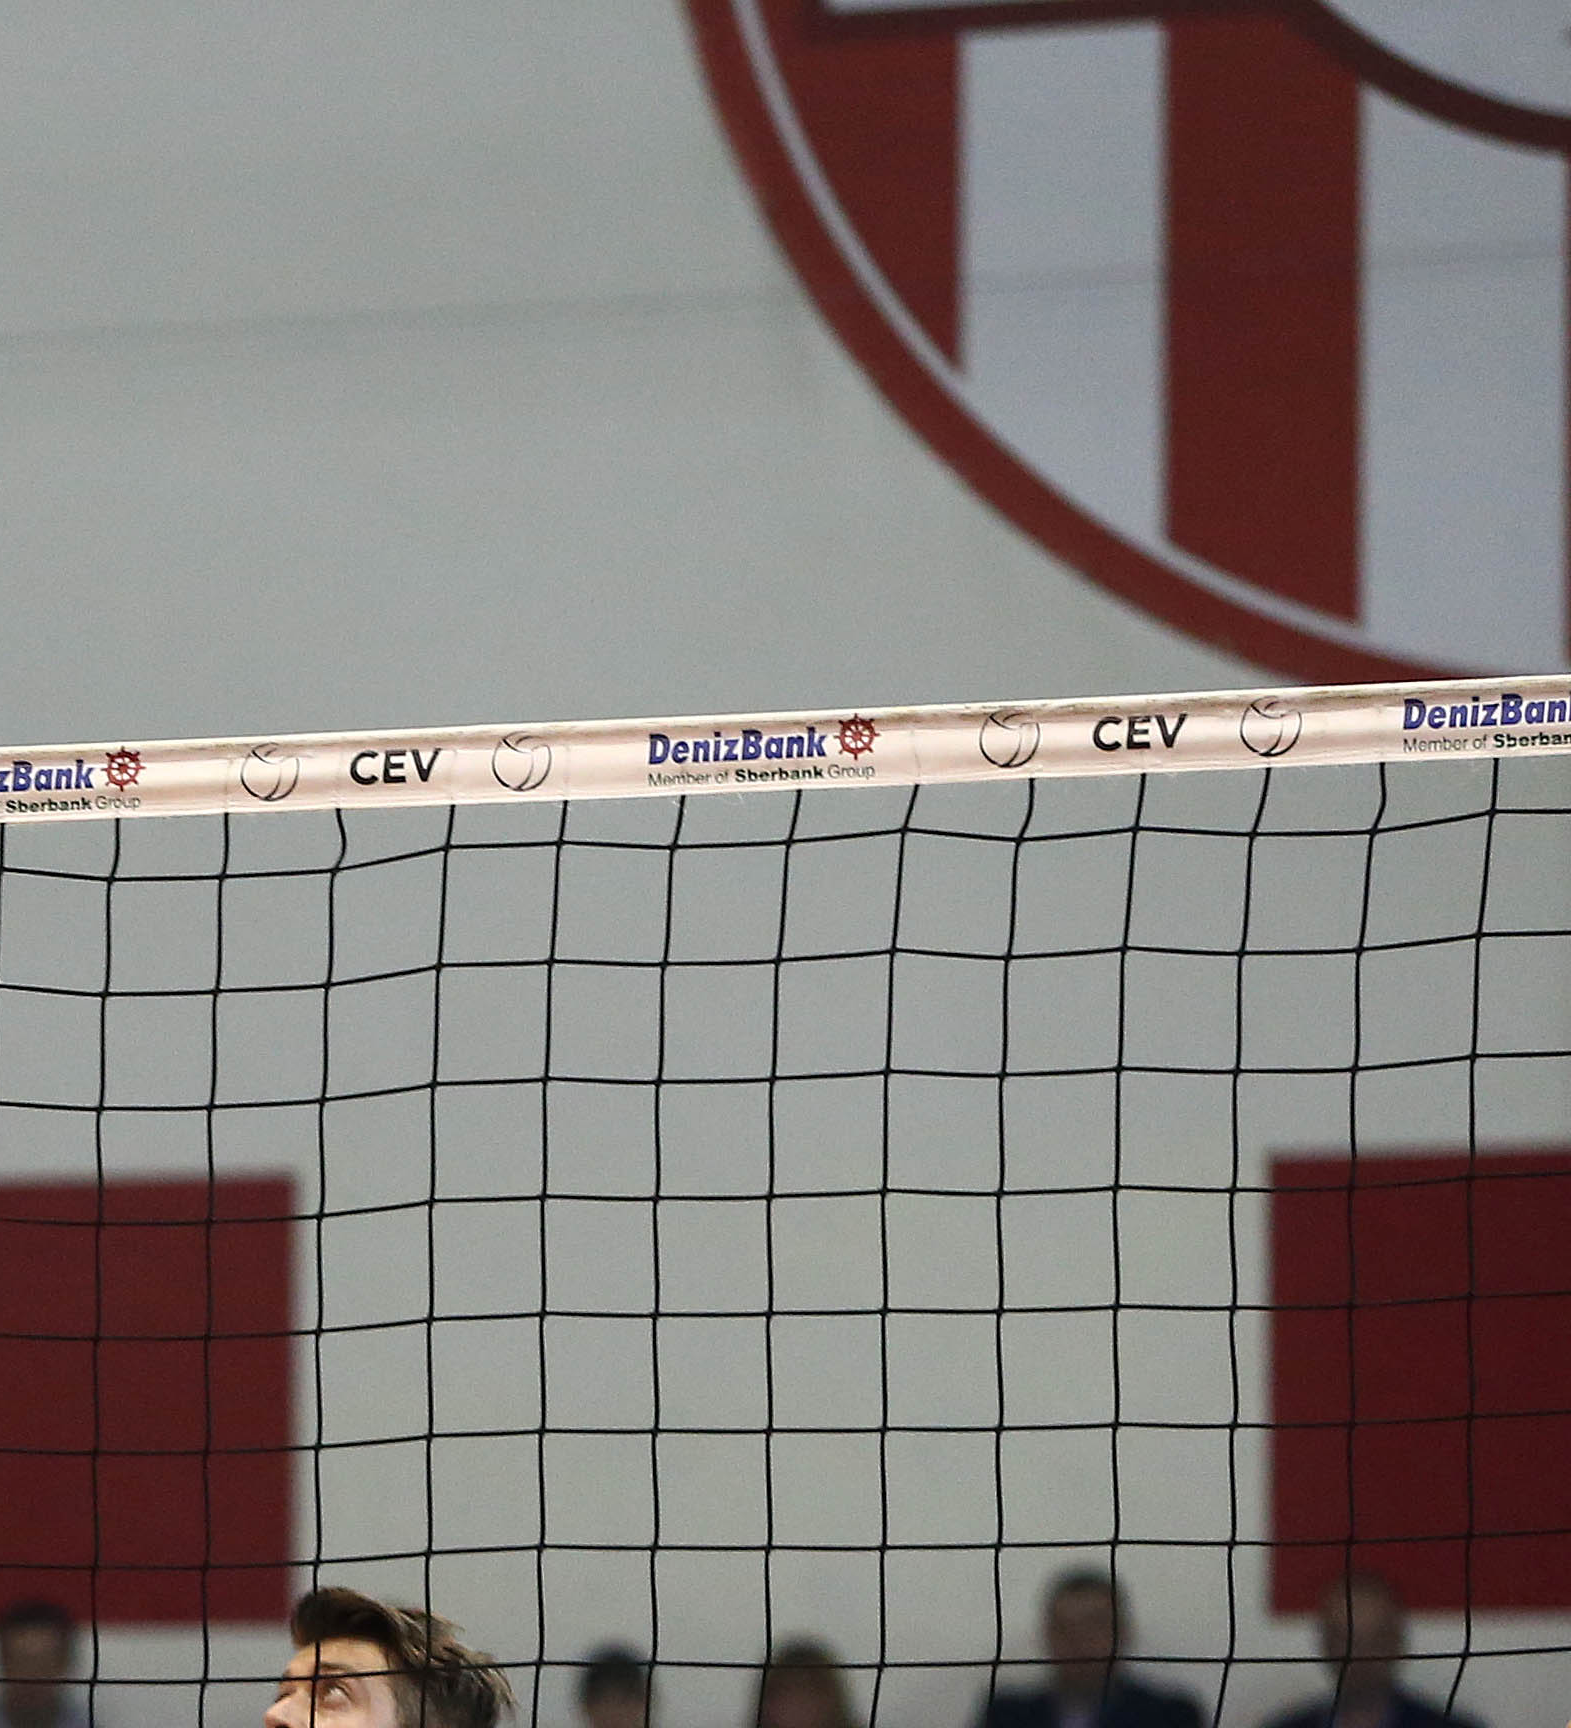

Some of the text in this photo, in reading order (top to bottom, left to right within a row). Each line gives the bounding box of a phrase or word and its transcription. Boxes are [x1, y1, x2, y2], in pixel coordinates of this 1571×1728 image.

[648, 726, 827, 765] DenizBank
[1092, 712, 1188, 752] CEV
[1403, 731, 1571, 752] Member of Sberban
[349, 747, 443, 786] CEV
[648, 764, 876, 787] Member of Sberbank Group
[5, 797, 93, 813] Sberbank
[95, 795, 142, 811] Group
